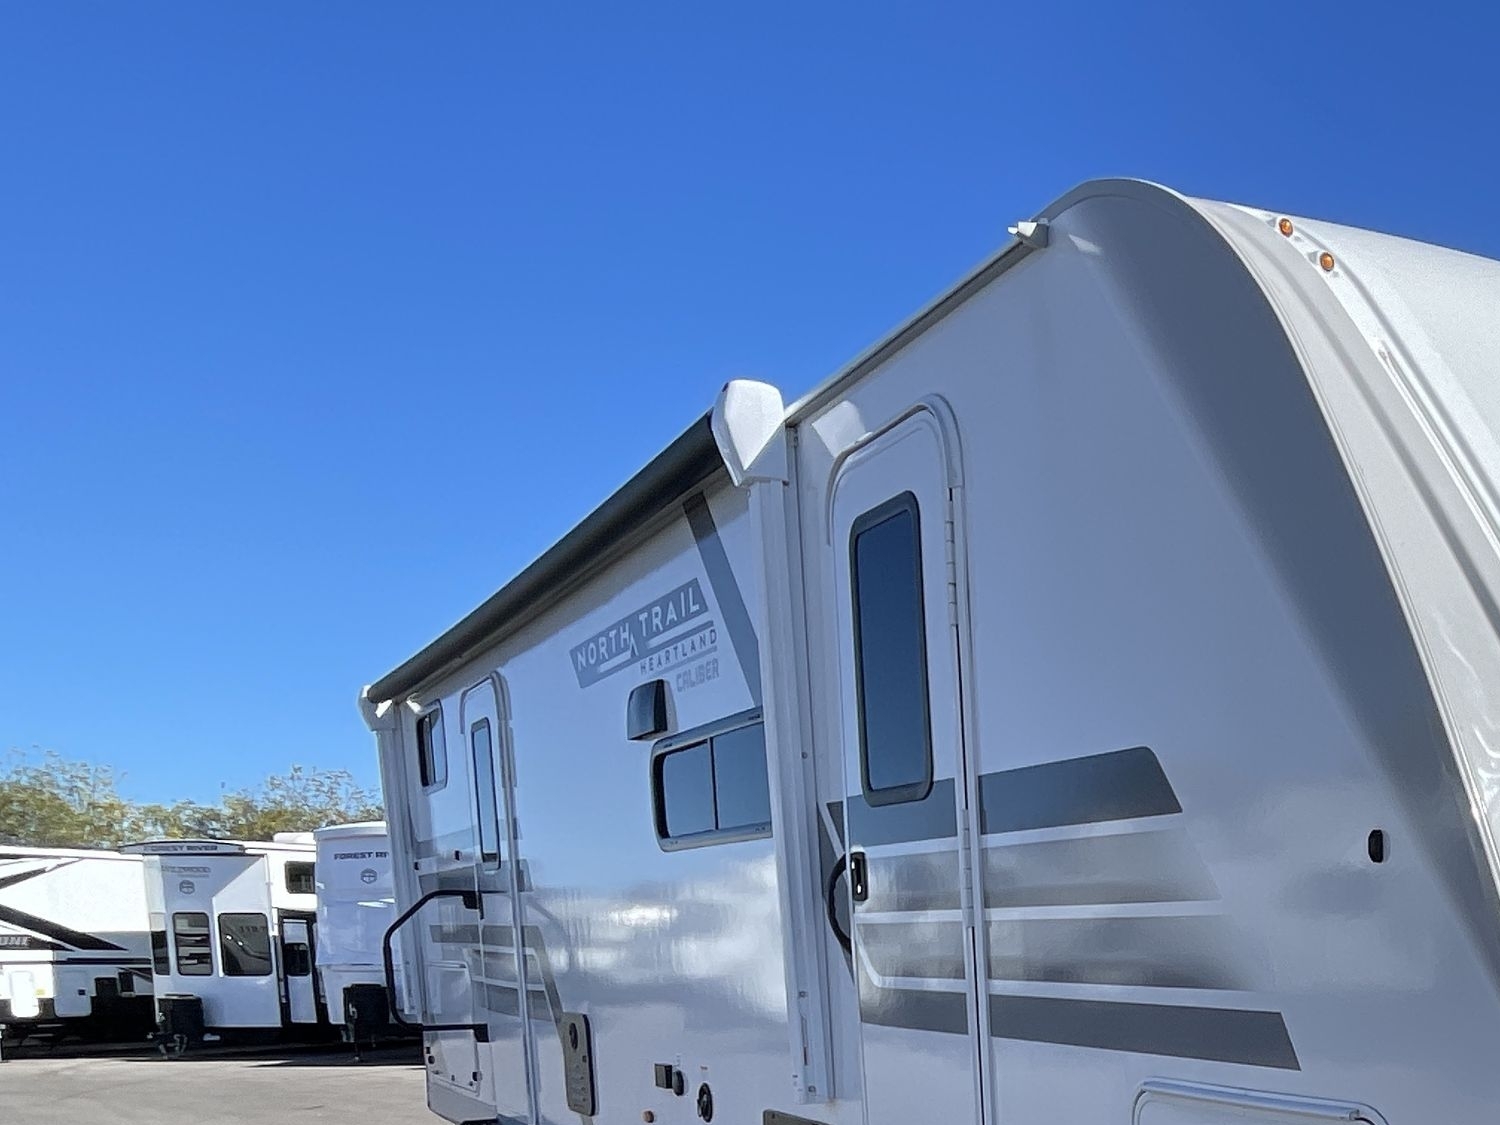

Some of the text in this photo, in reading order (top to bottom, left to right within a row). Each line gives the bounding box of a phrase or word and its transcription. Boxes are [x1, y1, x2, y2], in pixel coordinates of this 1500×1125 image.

[576, 586, 700, 671] NORTH TRAIL
[640, 628, 718, 675] HEARTLAND
[676, 657, 720, 693] CALIBER
[333, 851, 374, 861] FOREST
